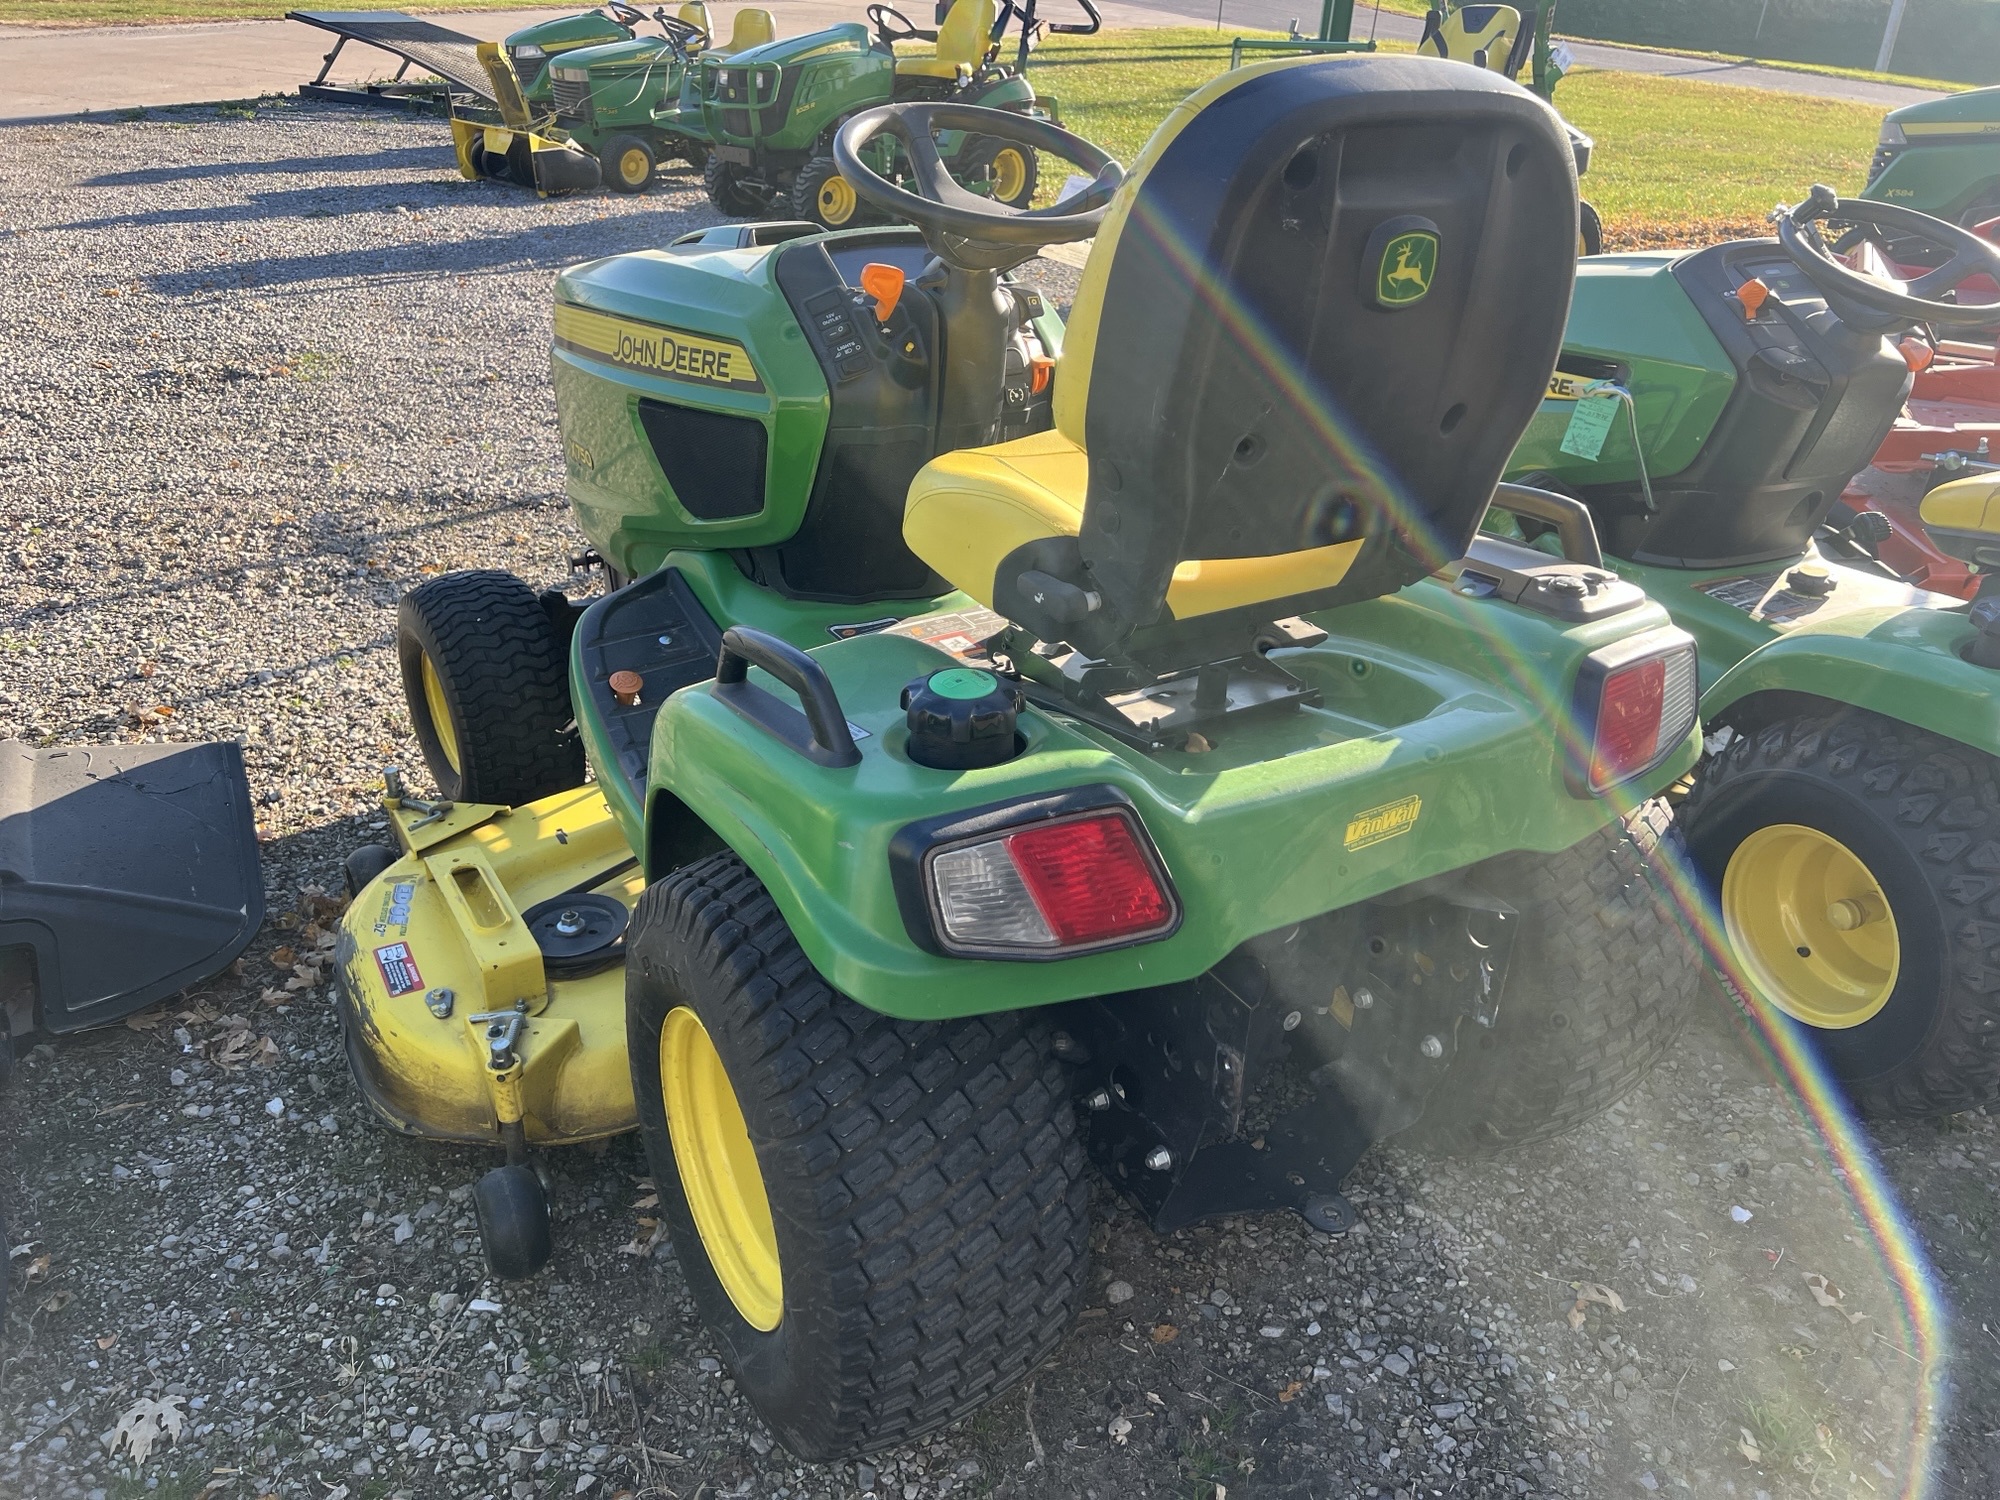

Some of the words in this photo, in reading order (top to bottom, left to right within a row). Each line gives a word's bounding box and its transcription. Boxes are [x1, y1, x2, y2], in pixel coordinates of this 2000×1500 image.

[1884, 188, 1914, 198] X584
[822, 314, 842, 326] OUTLET
[836, 341, 856, 352] LIGHTS
[612, 329, 656, 365] JOHN
[660, 337, 732, 379] DEERE
[388, 883, 414, 925] EDGE
